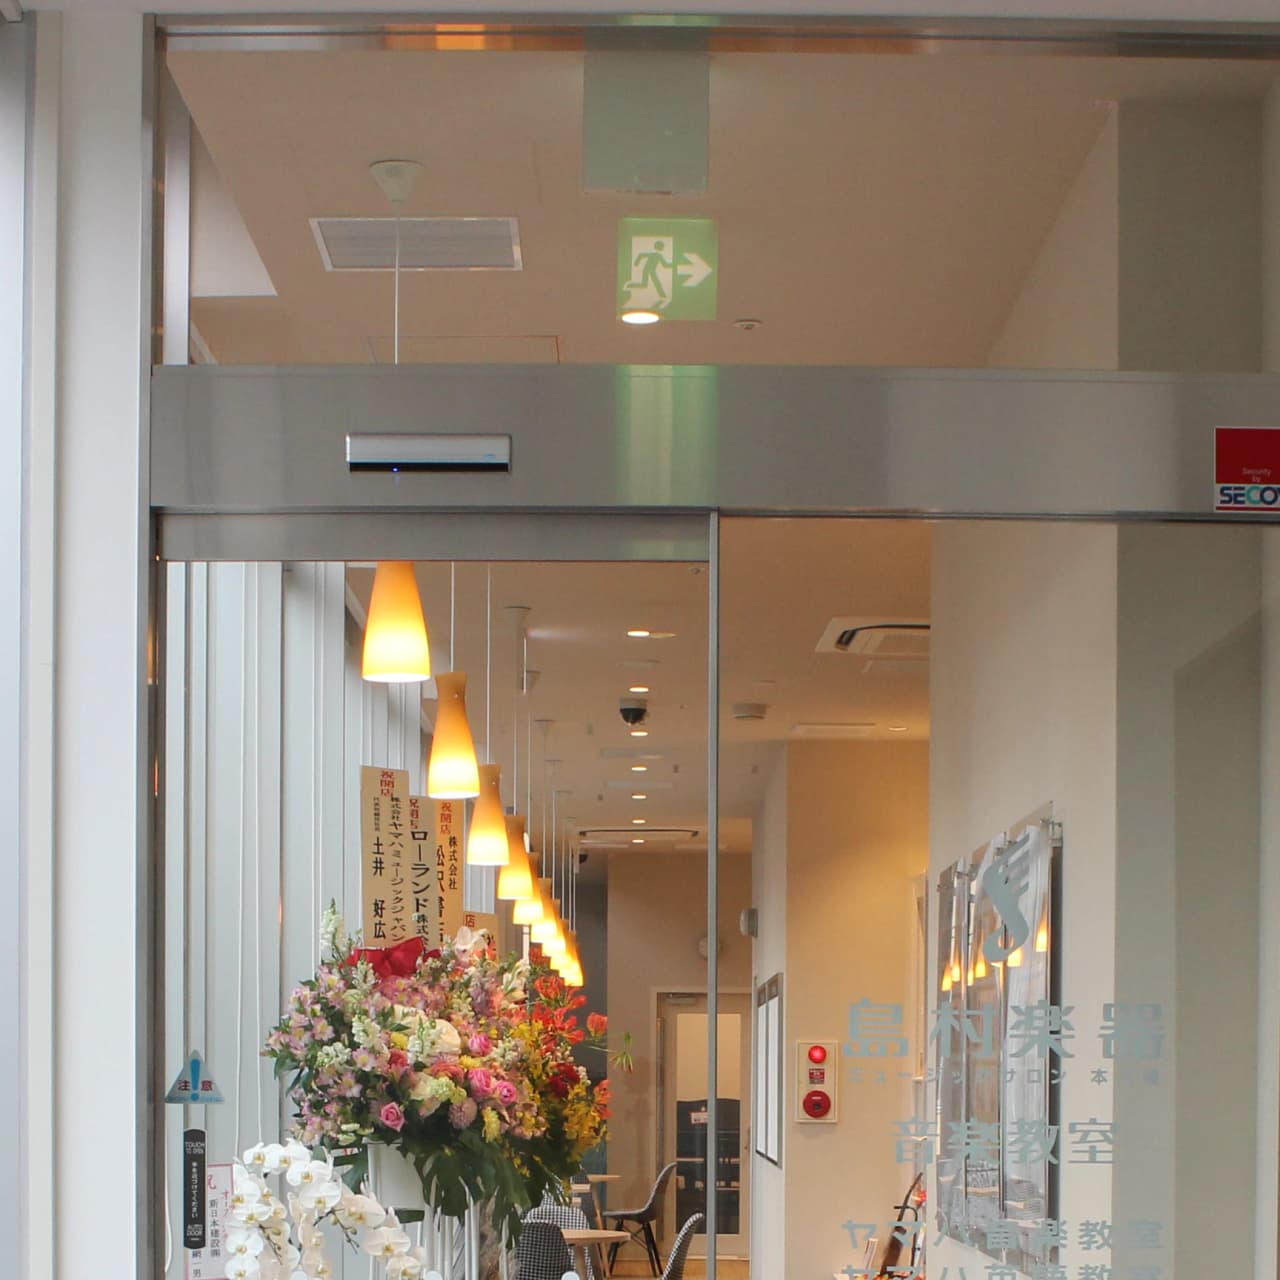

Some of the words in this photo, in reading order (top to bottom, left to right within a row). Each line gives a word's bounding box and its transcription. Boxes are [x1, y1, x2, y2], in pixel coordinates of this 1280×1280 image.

[372, 837, 385, 877] 土井
[449, 836, 458, 890] 株式会社
[373, 900, 387, 940] 好広
[843, 997, 1166, 1059] 島村楽器
[841, 1219, 1165, 1249] ヤマハ音楽教室
